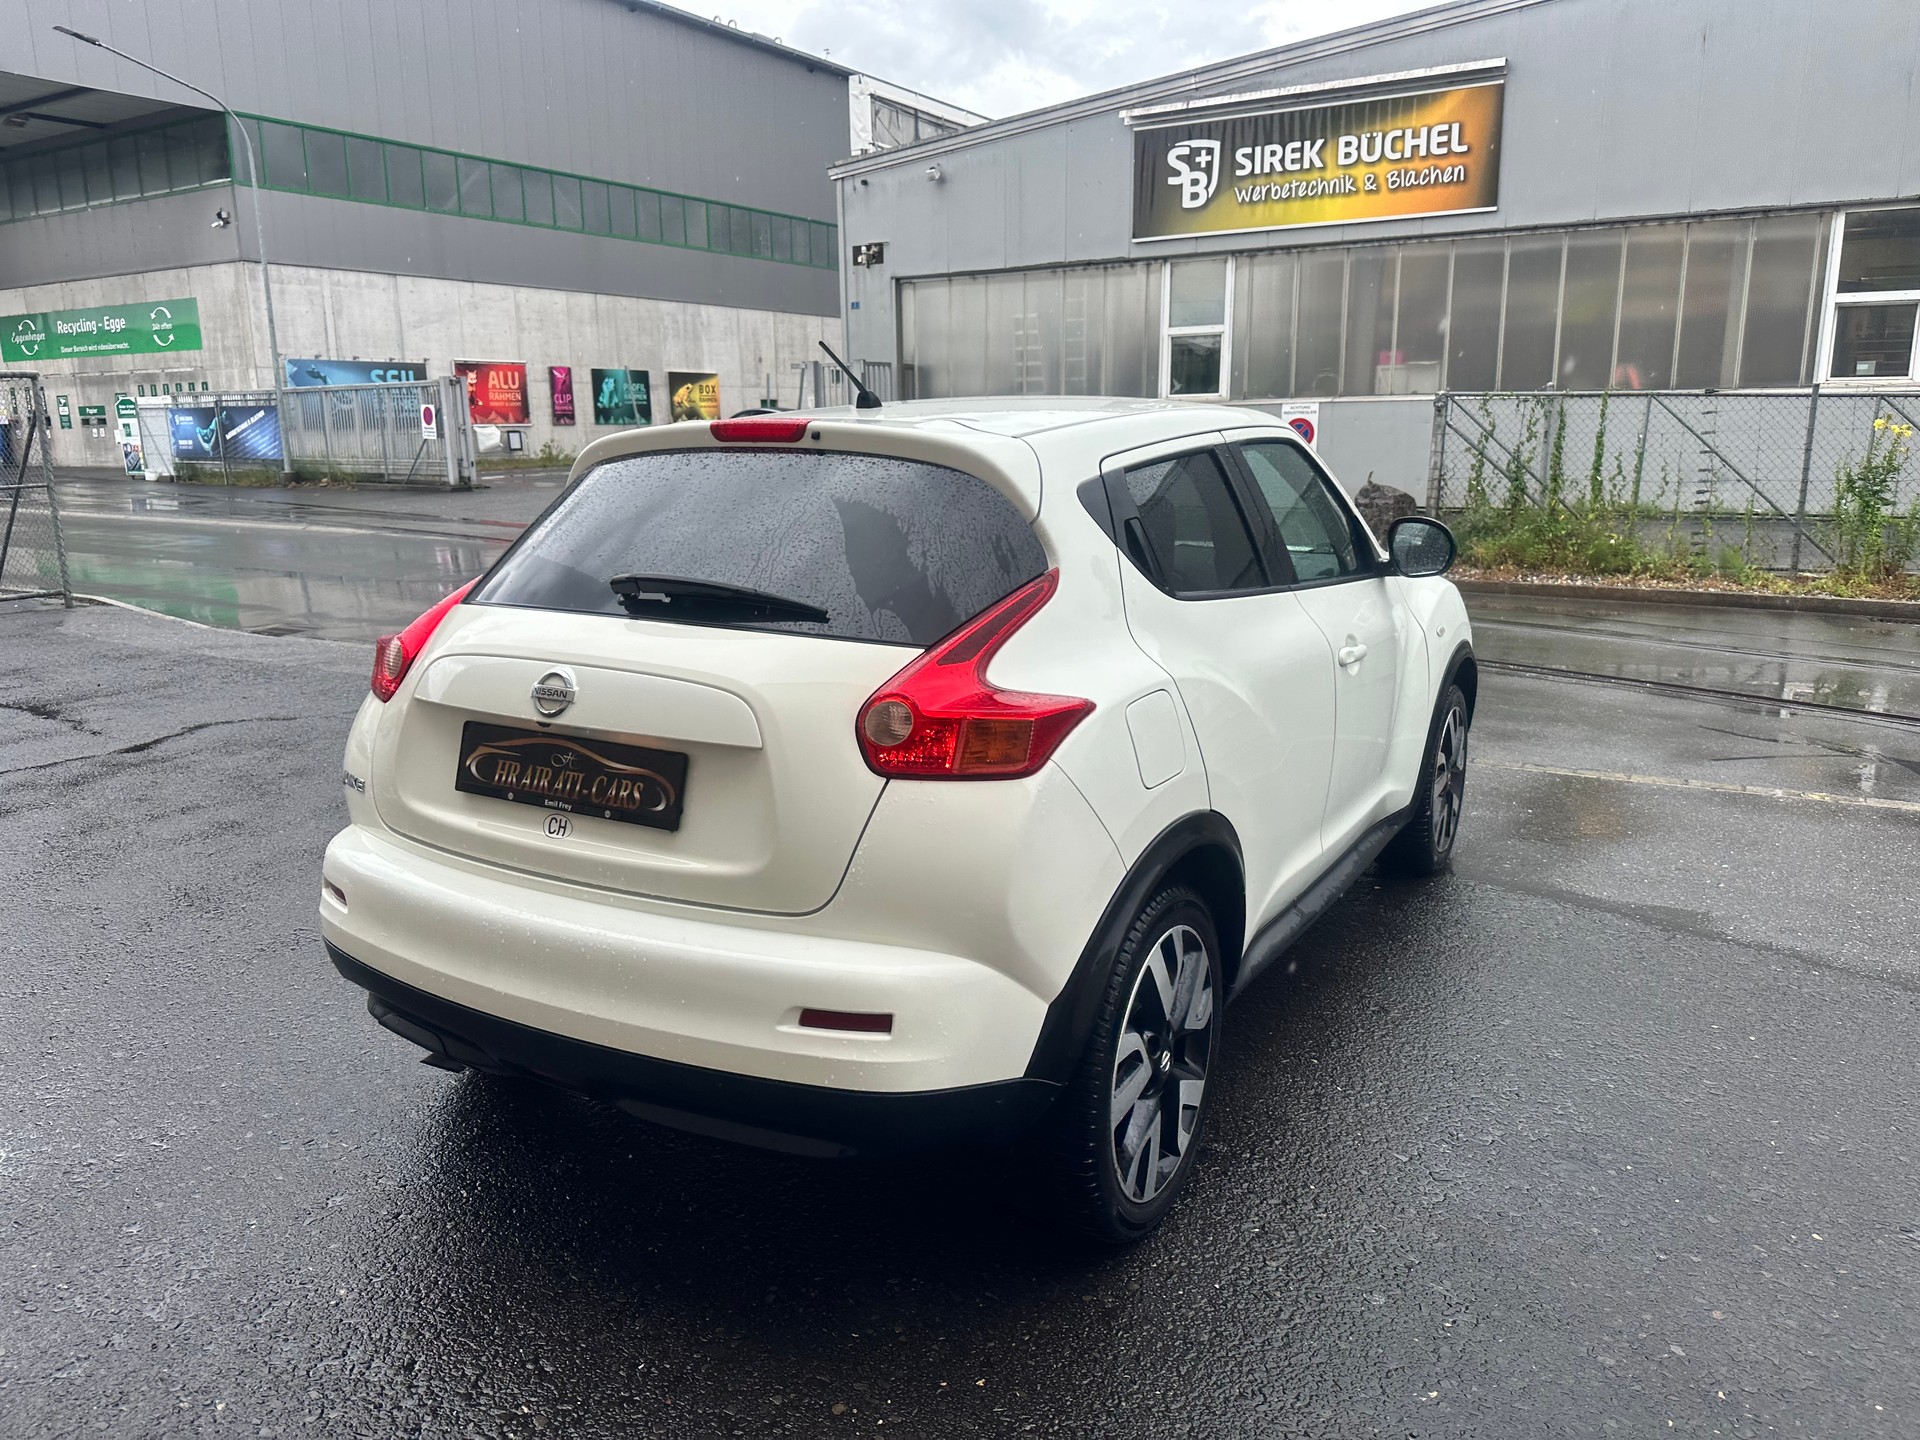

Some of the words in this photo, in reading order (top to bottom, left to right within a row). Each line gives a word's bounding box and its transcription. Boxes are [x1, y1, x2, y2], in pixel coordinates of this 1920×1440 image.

[1234, 138, 1325, 177] SIREK
[1337, 122, 1469, 167] BÜCHEL
[1234, 175, 1357, 204] Werbetechnik
[1363, 174, 1377, 191] &
[1386, 164, 1465, 189] Blachen
[57, 317, 97, 336] Recycling
[104, 316, 126, 333] Egge
[488, 371, 520, 389] ALU
[489, 391, 521, 401] RAHMEN
[698, 384, 717, 394] BOX
[553, 393, 572, 404] CLIP
[534, 686, 568, 698] NISSAN
[544, 799, 558, 808] Emil
[558, 801, 573, 811] Frey
[548, 817, 568, 837] CH
